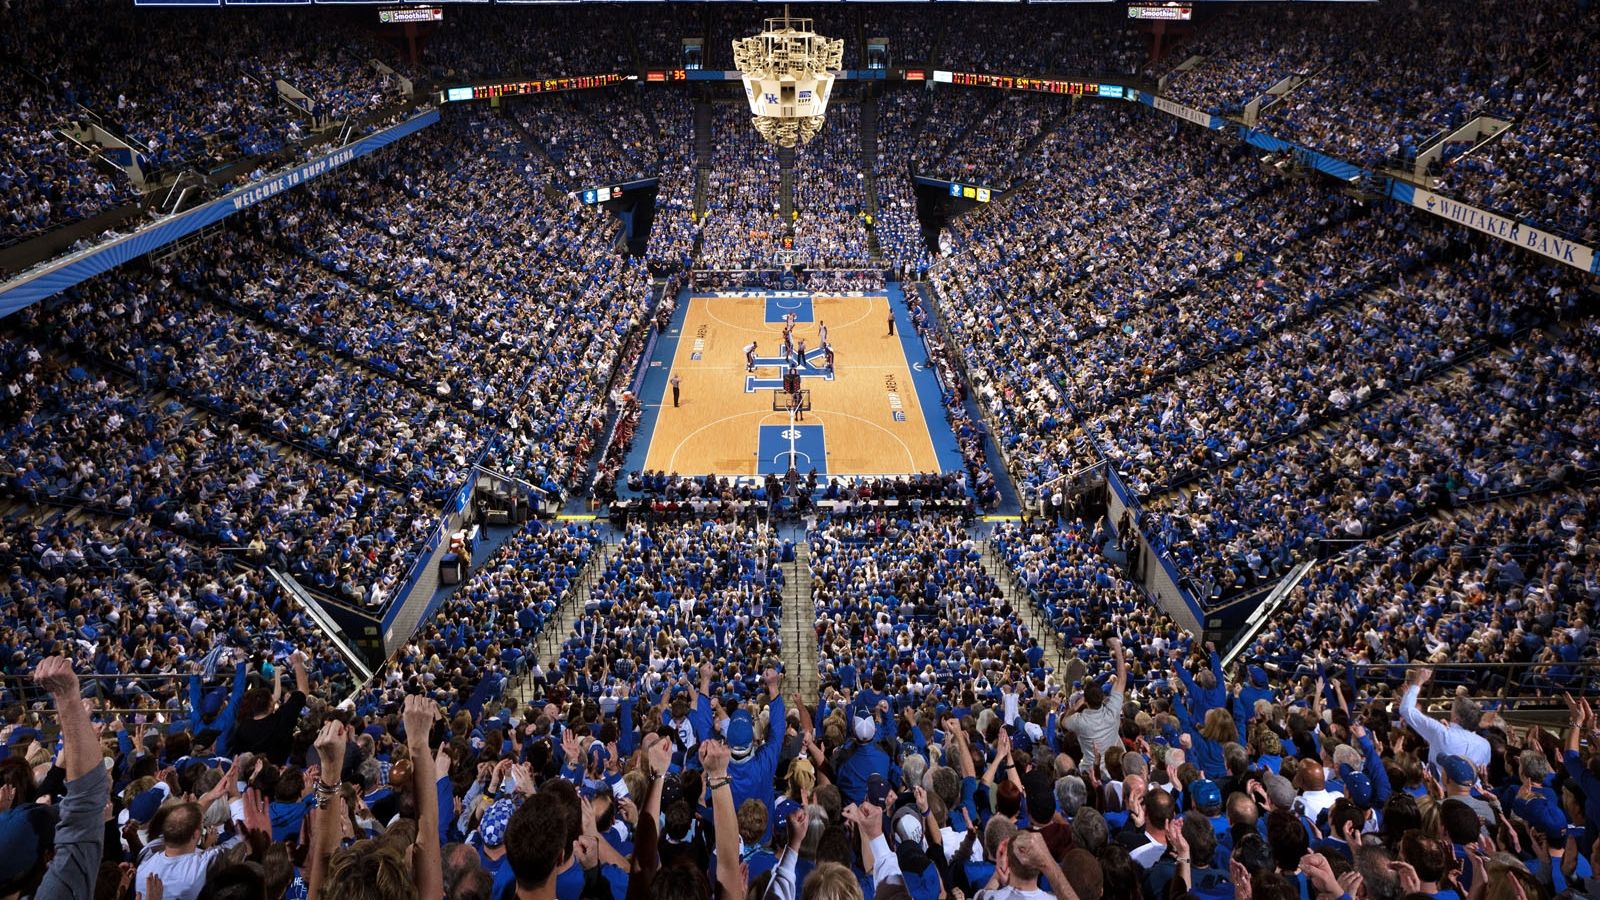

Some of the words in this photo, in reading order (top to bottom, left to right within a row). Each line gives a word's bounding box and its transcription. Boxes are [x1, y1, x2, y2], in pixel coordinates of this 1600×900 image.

[394, 12, 429, 20] Smoothies
[1141, 9, 1176, 17] Smoothies
[674, 70, 686, 80] 35
[764, 93, 779, 104] UK
[233, 179, 285, 210] WELCOME
[288, 173, 300, 186] TO
[303, 161, 326, 179] RUPP
[329, 149, 354, 168] ARENA
[1440, 200, 1520, 242] WHITAKER
[1527, 230, 1577, 263] BANK
